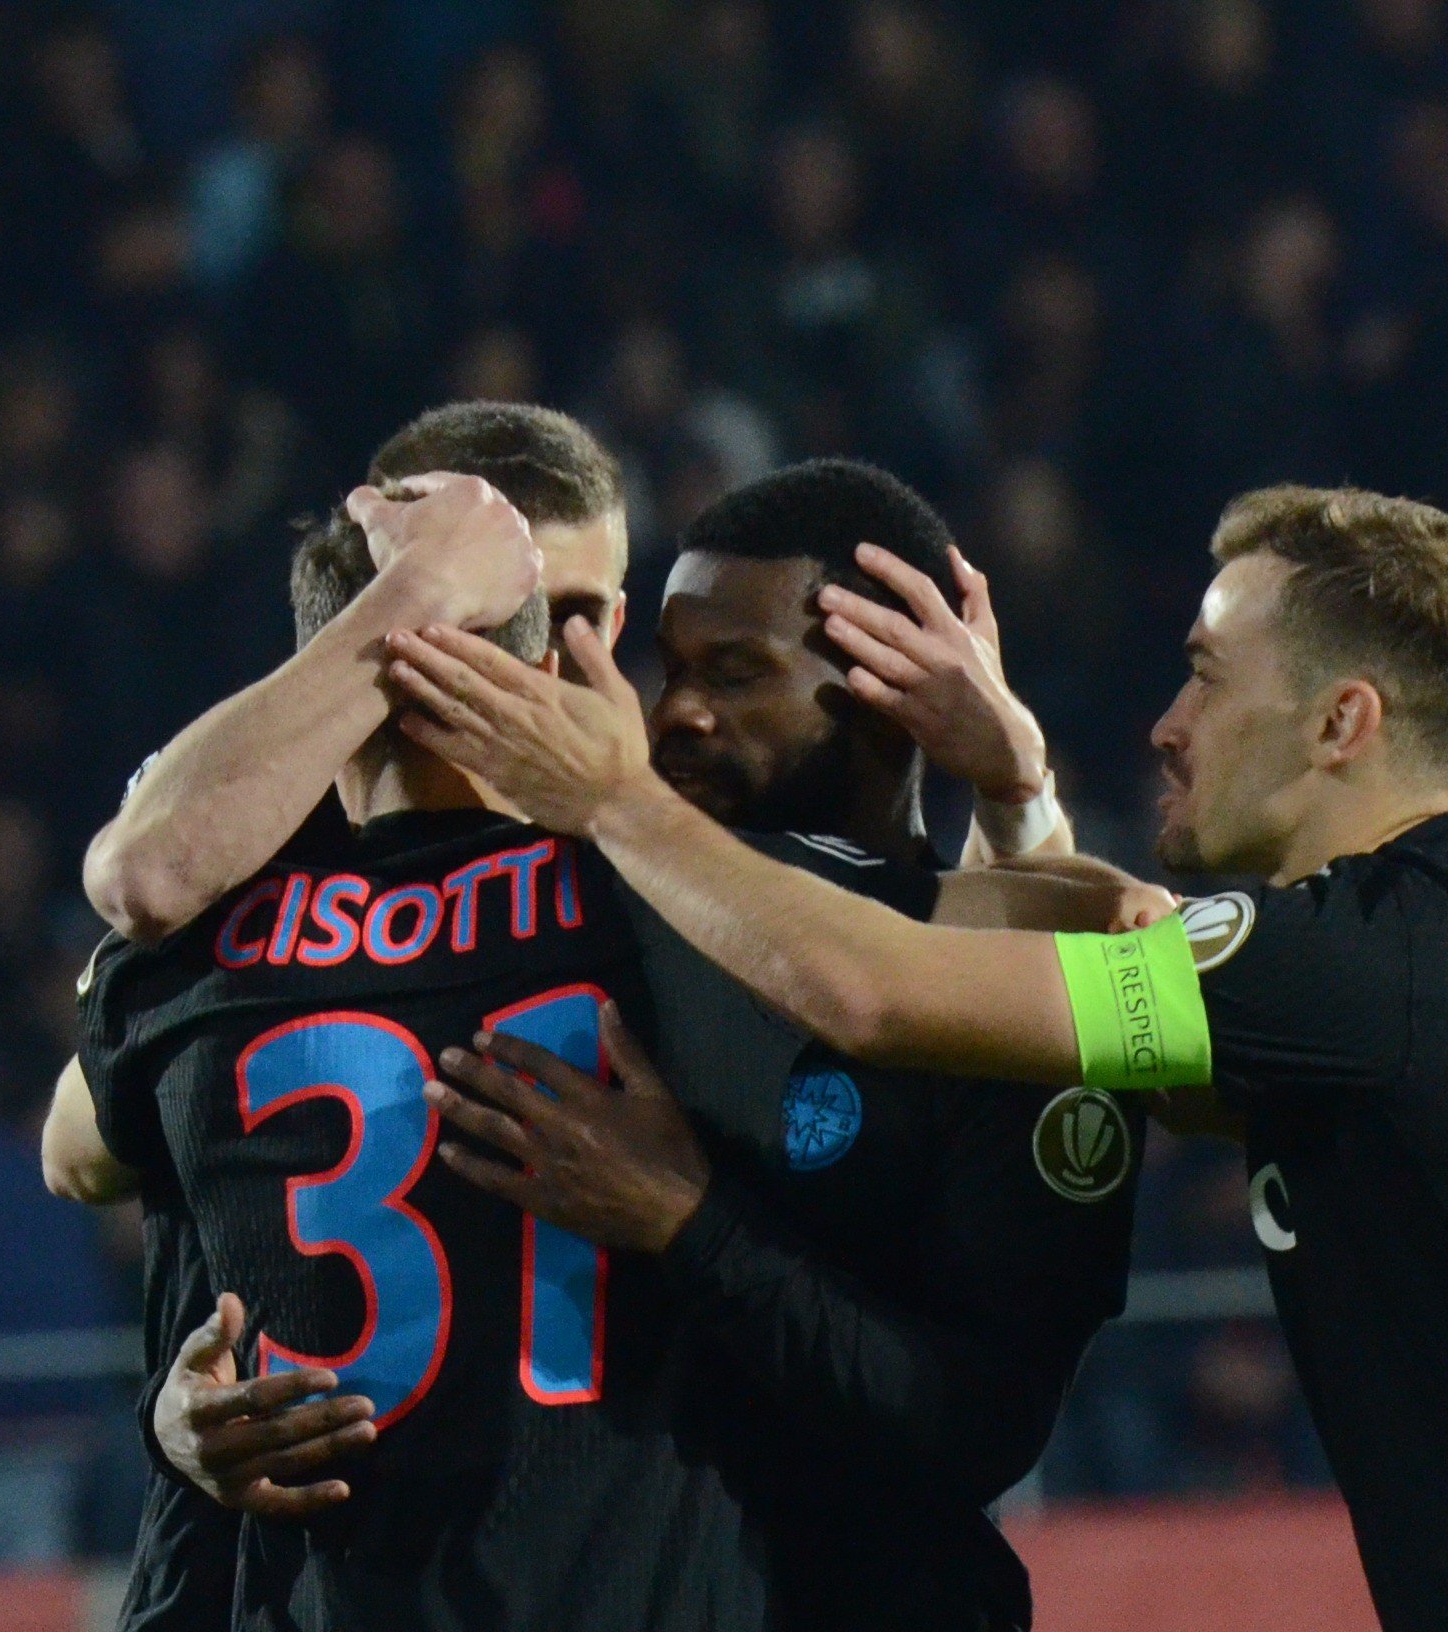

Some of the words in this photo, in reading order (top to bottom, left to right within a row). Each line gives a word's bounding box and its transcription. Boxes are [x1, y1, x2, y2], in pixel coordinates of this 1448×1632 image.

[213, 838, 585, 970] CISOTTI
[1118, 966, 1158, 1074] RESPECT
[236, 982, 610, 1434] 31
